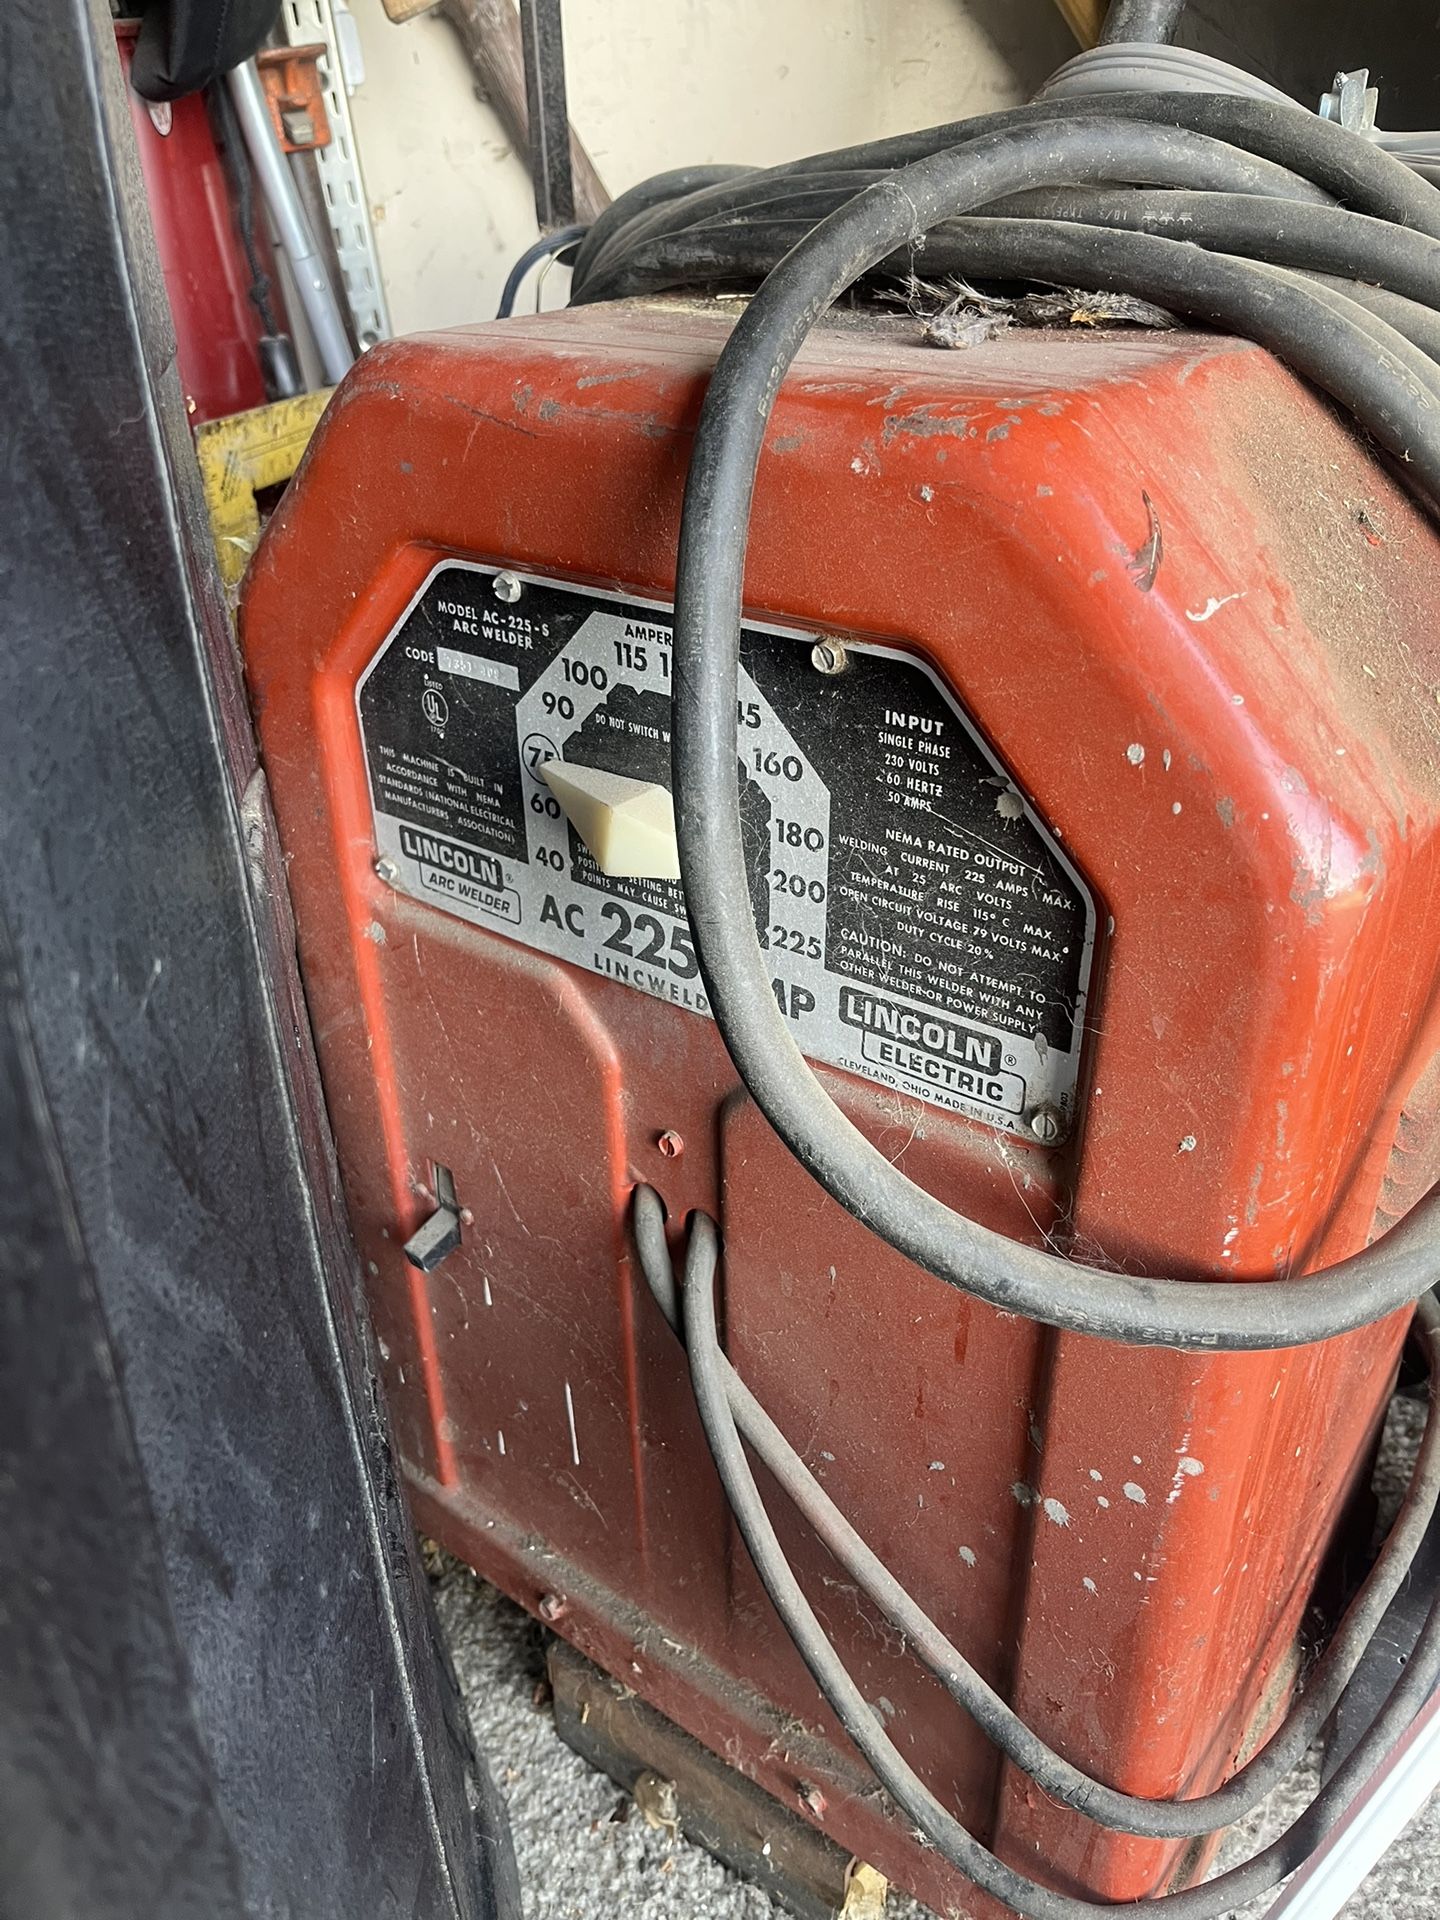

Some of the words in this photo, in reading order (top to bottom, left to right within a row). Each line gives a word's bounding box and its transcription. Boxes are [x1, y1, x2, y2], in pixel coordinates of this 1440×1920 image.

[438, 601, 477, 620] MODEL
[453, 620, 478, 636] ARC
[482, 626, 534, 650] WELDER
[625, 623, 673, 646] AMPER
[405, 646, 435, 664] CODE
[614, 641, 647, 672] 115
[562, 658, 608, 691] 100
[542, 691, 575, 720] 90
[885, 709, 944, 736] INPUT
[595, 713, 606, 725] DO
[609, 716, 625, 731] NOT
[628, 721, 659, 740] SWITCH
[878, 731, 914, 750] SINGLE
[918, 740, 951, 759] PHASE
[379, 745, 396, 758] THIS
[402, 753, 440, 773] MACHINE
[447, 767, 455, 778] IS
[463, 772, 485, 787] BUILT
[493, 782, 504, 796] IN
[752, 748, 803, 782] 160
[885, 753, 904, 768] 230
[908, 758, 940, 776] VOLTS
[378, 774, 424, 797] STANDARDS
[470, 805, 516, 829] ELECTRICAL
[386, 762, 439, 787] ACCORDANCE
[446, 781, 468, 797] WITH
[475, 791, 501, 809] NEMA
[886, 772, 901, 786] 60
[906, 776, 943, 797] HERTZ
[888, 791, 901, 804] 50
[903, 796, 933, 813] AMPS
[384, 790, 450, 820] MANUFACTURERS
[530, 792, 561, 820] 60
[775, 818, 824, 853] 180
[885, 828, 922, 848] NEMA
[927, 840, 970, 860] RATED
[974, 853, 1026, 877] OUTPUT
[404, 831, 498, 886] LINCOLN
[535, 846, 565, 872] 40
[838, 834, 888, 856] WELDING
[900, 851, 950, 874] CURRENT
[964, 869, 986, 884] 225
[995, 880, 1029, 897] AMPS
[429, 872, 456, 891] ARC
[458, 883, 511, 914] WELDER
[582, 871, 611, 889] POINTS
[617, 883, 636, 898] MAY
[642, 891, 668, 909] CAUSE
[773, 869, 826, 904] 200
[850, 871, 925, 902] TEMPERATURE
[936, 897, 960, 913] RISE
[1002, 917, 1011, 928] C
[885, 865, 900, 876] AT
[911, 872, 926, 885] 25
[939, 881, 963, 896] ARC
[976, 891, 1012, 910] VOLTS
[839, 886, 868, 902] OPEN
[871, 896, 912, 916] CIRCUIT
[915, 908, 969, 934] VOLTAGE
[973, 925, 988, 938] 79
[991, 932, 1027, 952] VOLTS
[897, 921, 925, 938] DUTY
[929, 932, 963, 950] CYCLE
[540, 894, 585, 938] AC
[601, 901, 699, 980] 225
[772, 925, 823, 960] 225
[594, 952, 709, 1011] LINCWELD
[840, 927, 907, 958] CAUTION:
[914, 953, 932, 967] DO
[938, 961, 964, 977] NOT
[969, 971, 1023, 997] ATTEMPT
[1030, 989, 1046, 1004] TO
[840, 945, 893, 971] PARALLEL
[899, 964, 922, 980] THIS
[927, 974, 974, 998] WELDER
[979, 991, 1010, 1010] WITH
[1015, 1004, 1043, 1020] ANY
[840, 960, 875, 980] OTHER
[946, 996, 988, 1019] POWER
[992, 1012, 1036, 1034] SUPPLY
[846, 994, 993, 1068] LINCOLN
[879, 1041, 1004, 1102] ELECTRIC
[902, 1081, 931, 1099] OHIO
[934, 1092, 967, 1112] MADE
[970, 1106, 983, 1117] IN
